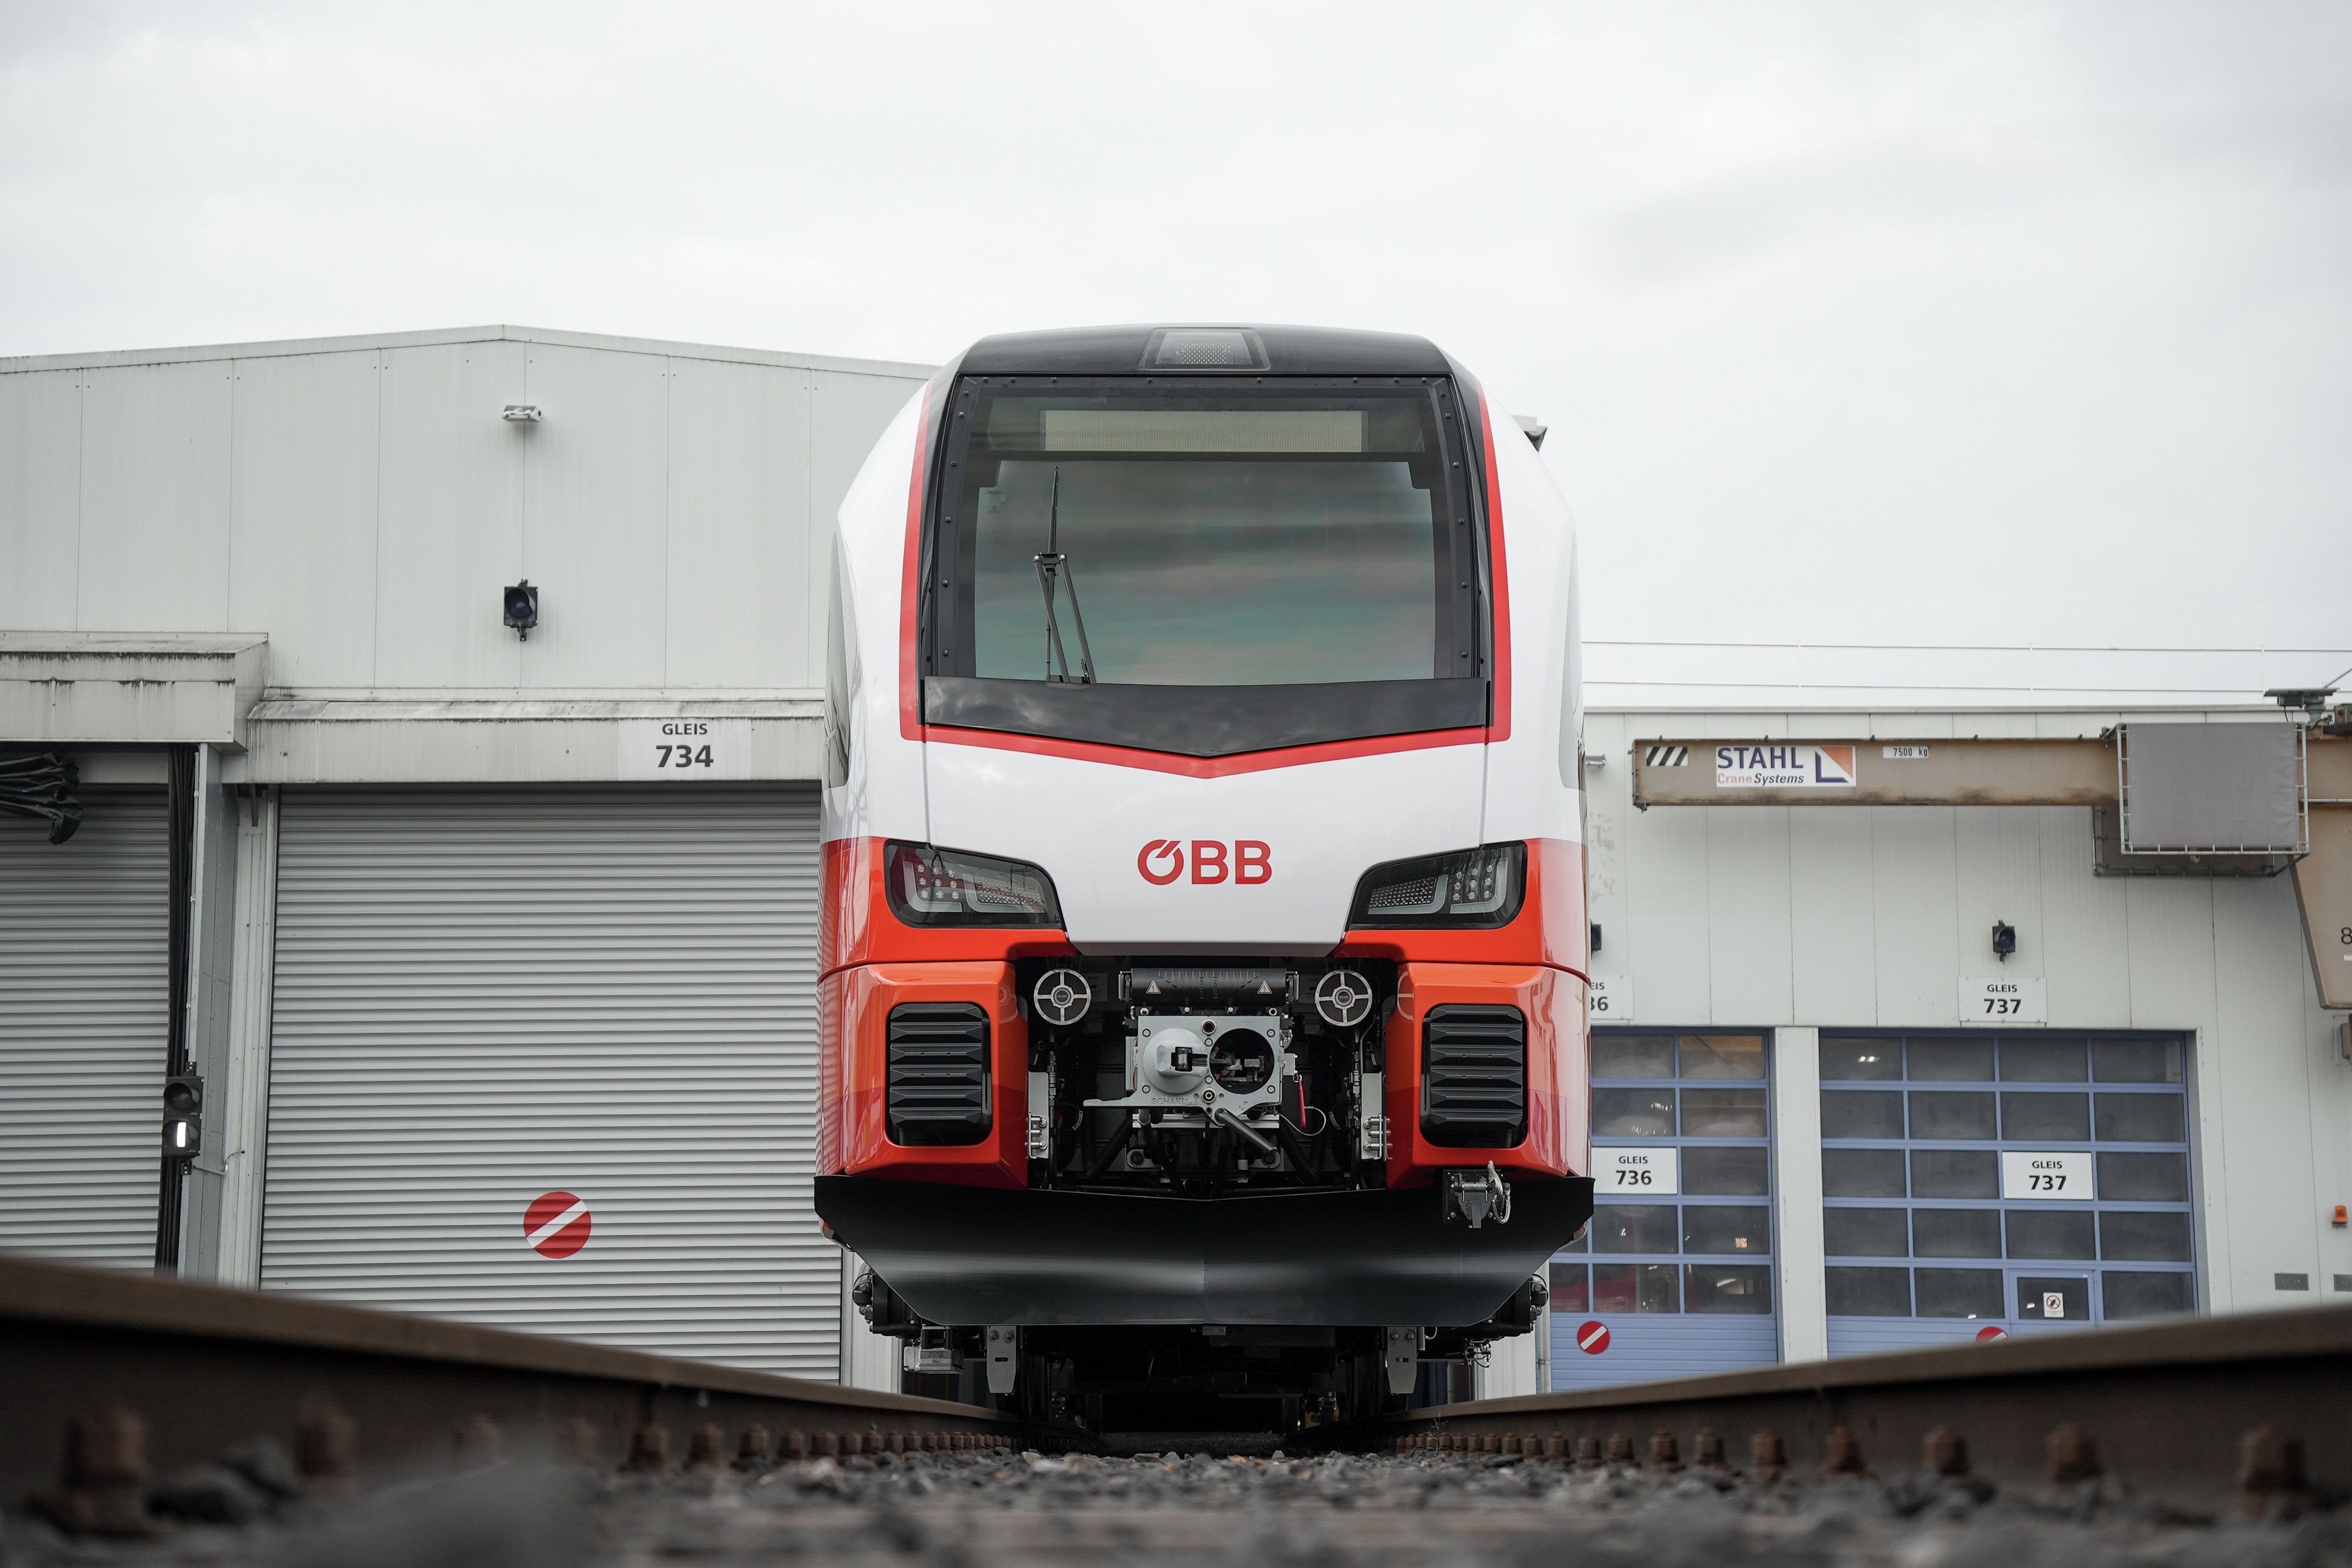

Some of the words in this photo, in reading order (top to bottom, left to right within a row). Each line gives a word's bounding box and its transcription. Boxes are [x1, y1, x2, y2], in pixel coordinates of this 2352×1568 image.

[662, 723, 707, 735] GLEIS
[656, 744, 714, 768] 734
[1717, 746, 1804, 769] STAHL
[1893, 747, 1912, 757] 7500
[1919, 746, 1927, 757] kg
[1137, 839, 1272, 885] ÖBB
[1591, 982, 1605, 990] EIS
[1987, 984, 2017, 992] GLEIS
[1984, 998, 2022, 1014] 737
[1619, 1156, 1648, 1164] GLEIS
[2032, 1161, 2063, 1169] GLEIS
[1616, 1170, 1652, 1185] 736
[2029, 1175, 2067, 1191] 737
